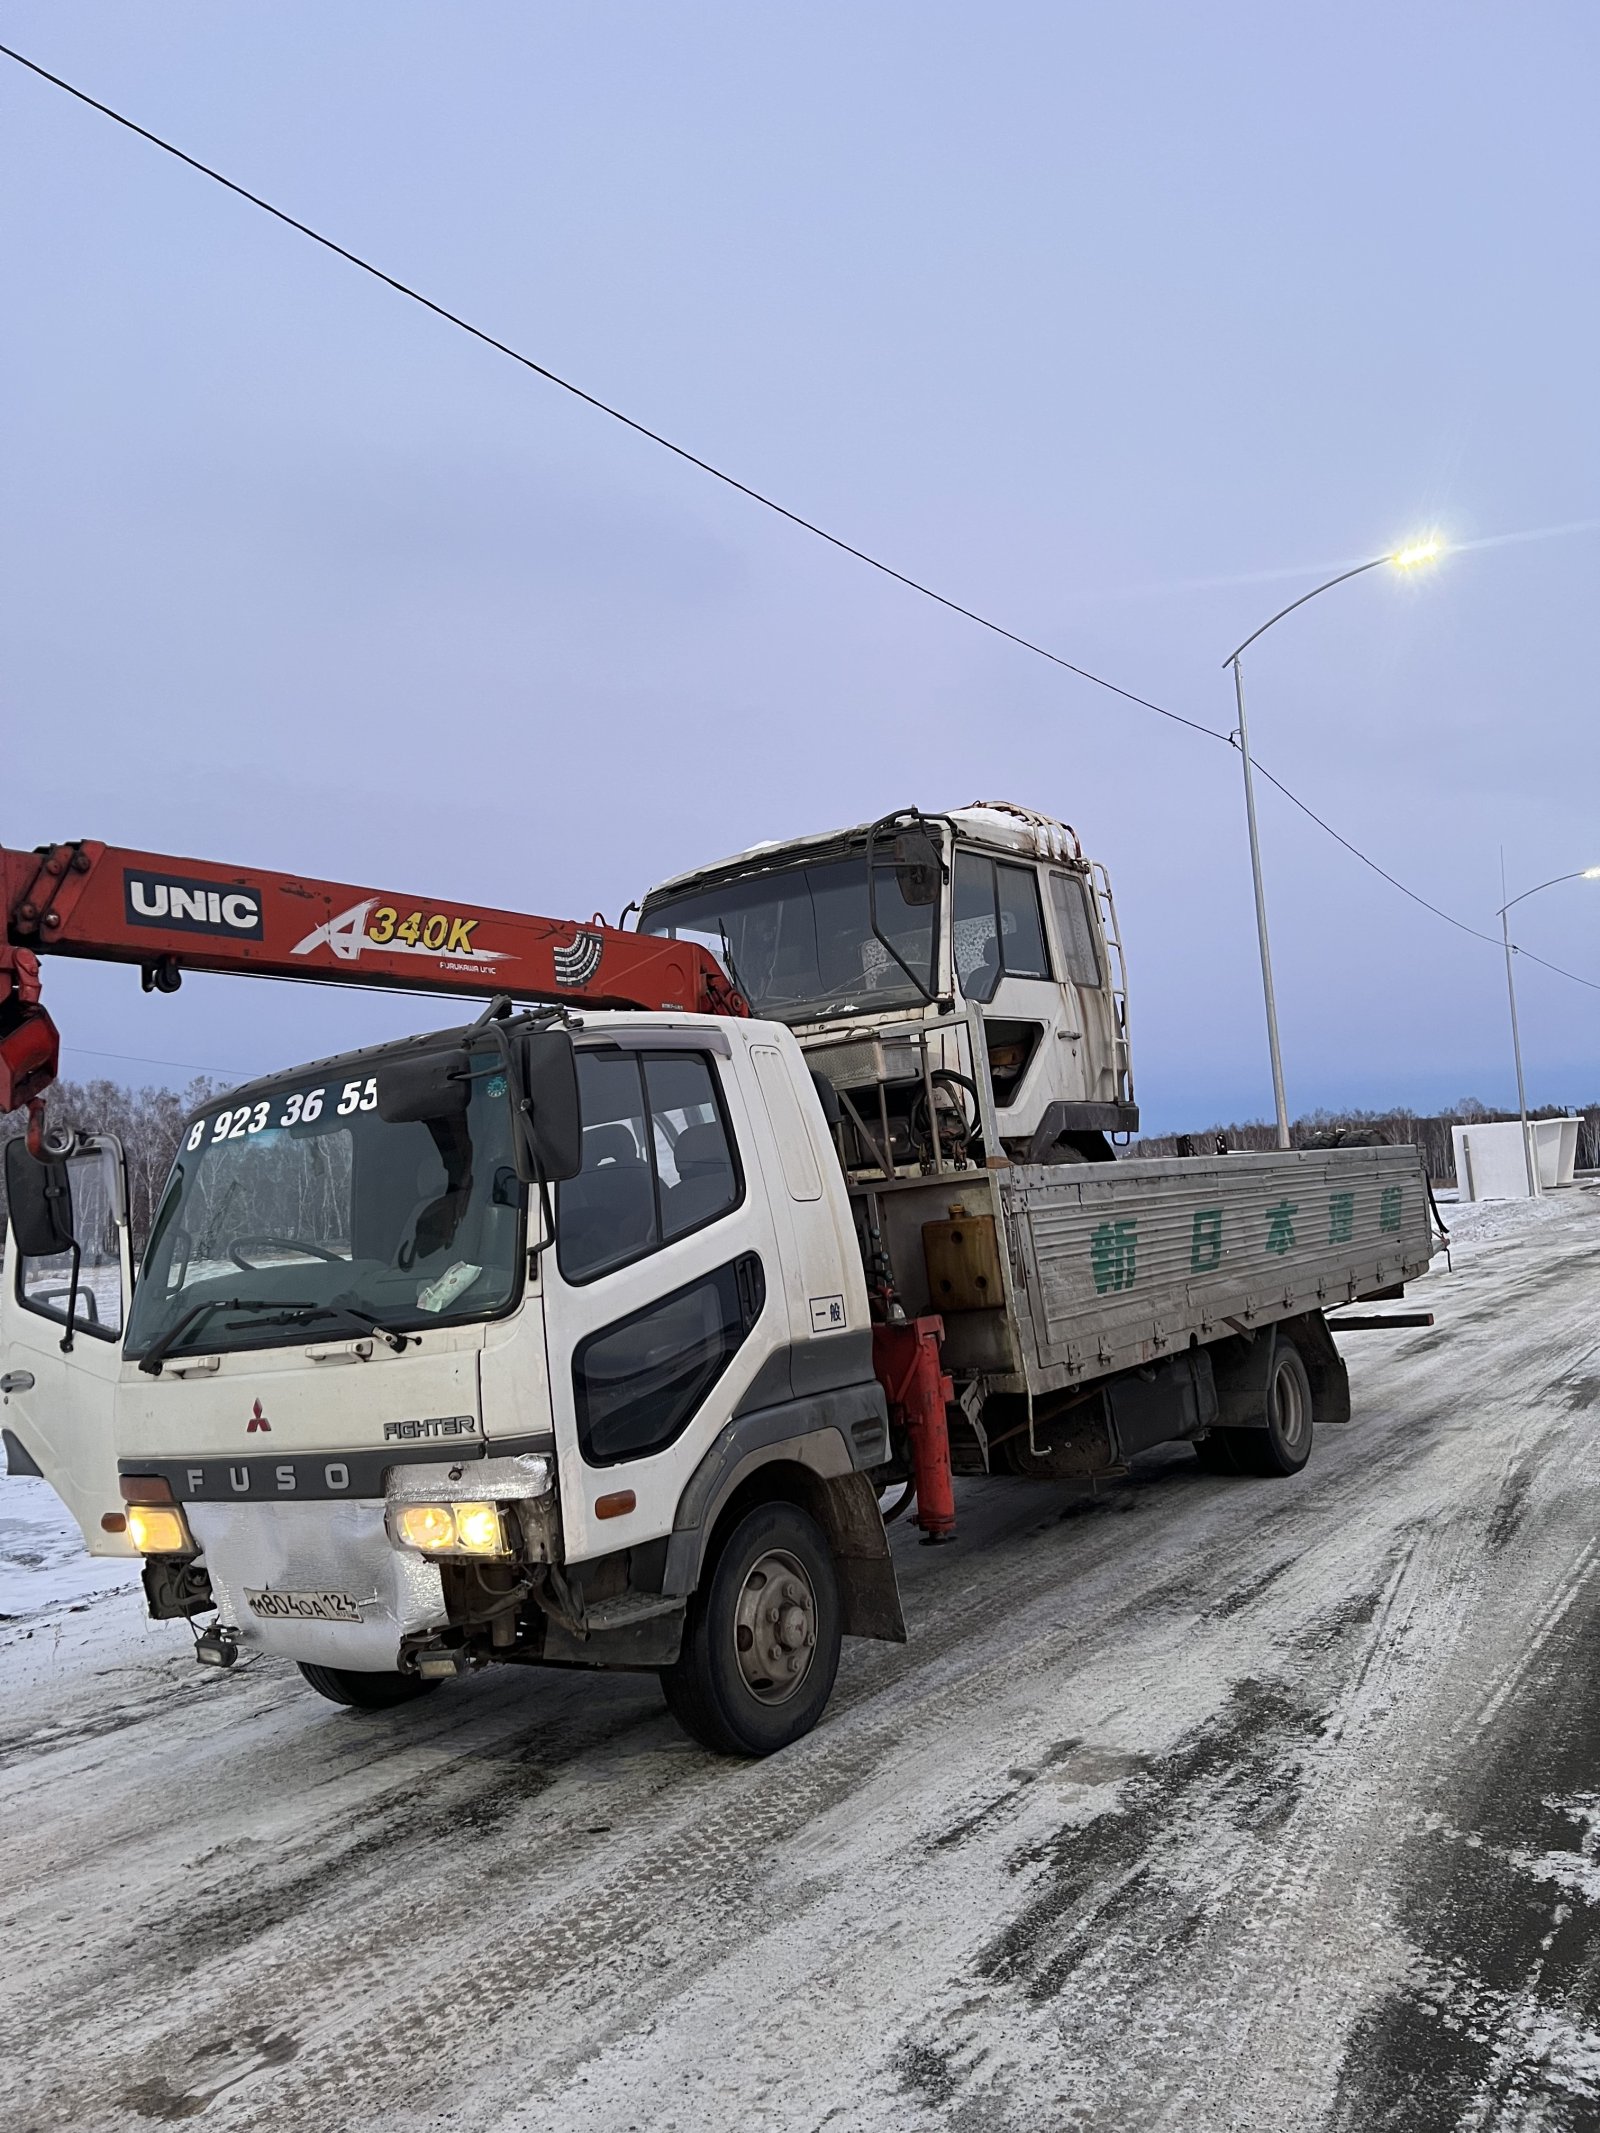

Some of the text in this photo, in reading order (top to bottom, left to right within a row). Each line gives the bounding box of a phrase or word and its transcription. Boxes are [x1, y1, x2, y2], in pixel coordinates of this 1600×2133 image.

[130, 881, 258, 928] UNIC
[440, 961, 479, 972] FURUKAWA
[187, 1078, 378, 1151] 8 923 36 55
[815, 1302, 842, 1322] 一般
[383, 1415, 476, 1440] FIGHTER
[187, 1463, 349, 1493] FUSO
